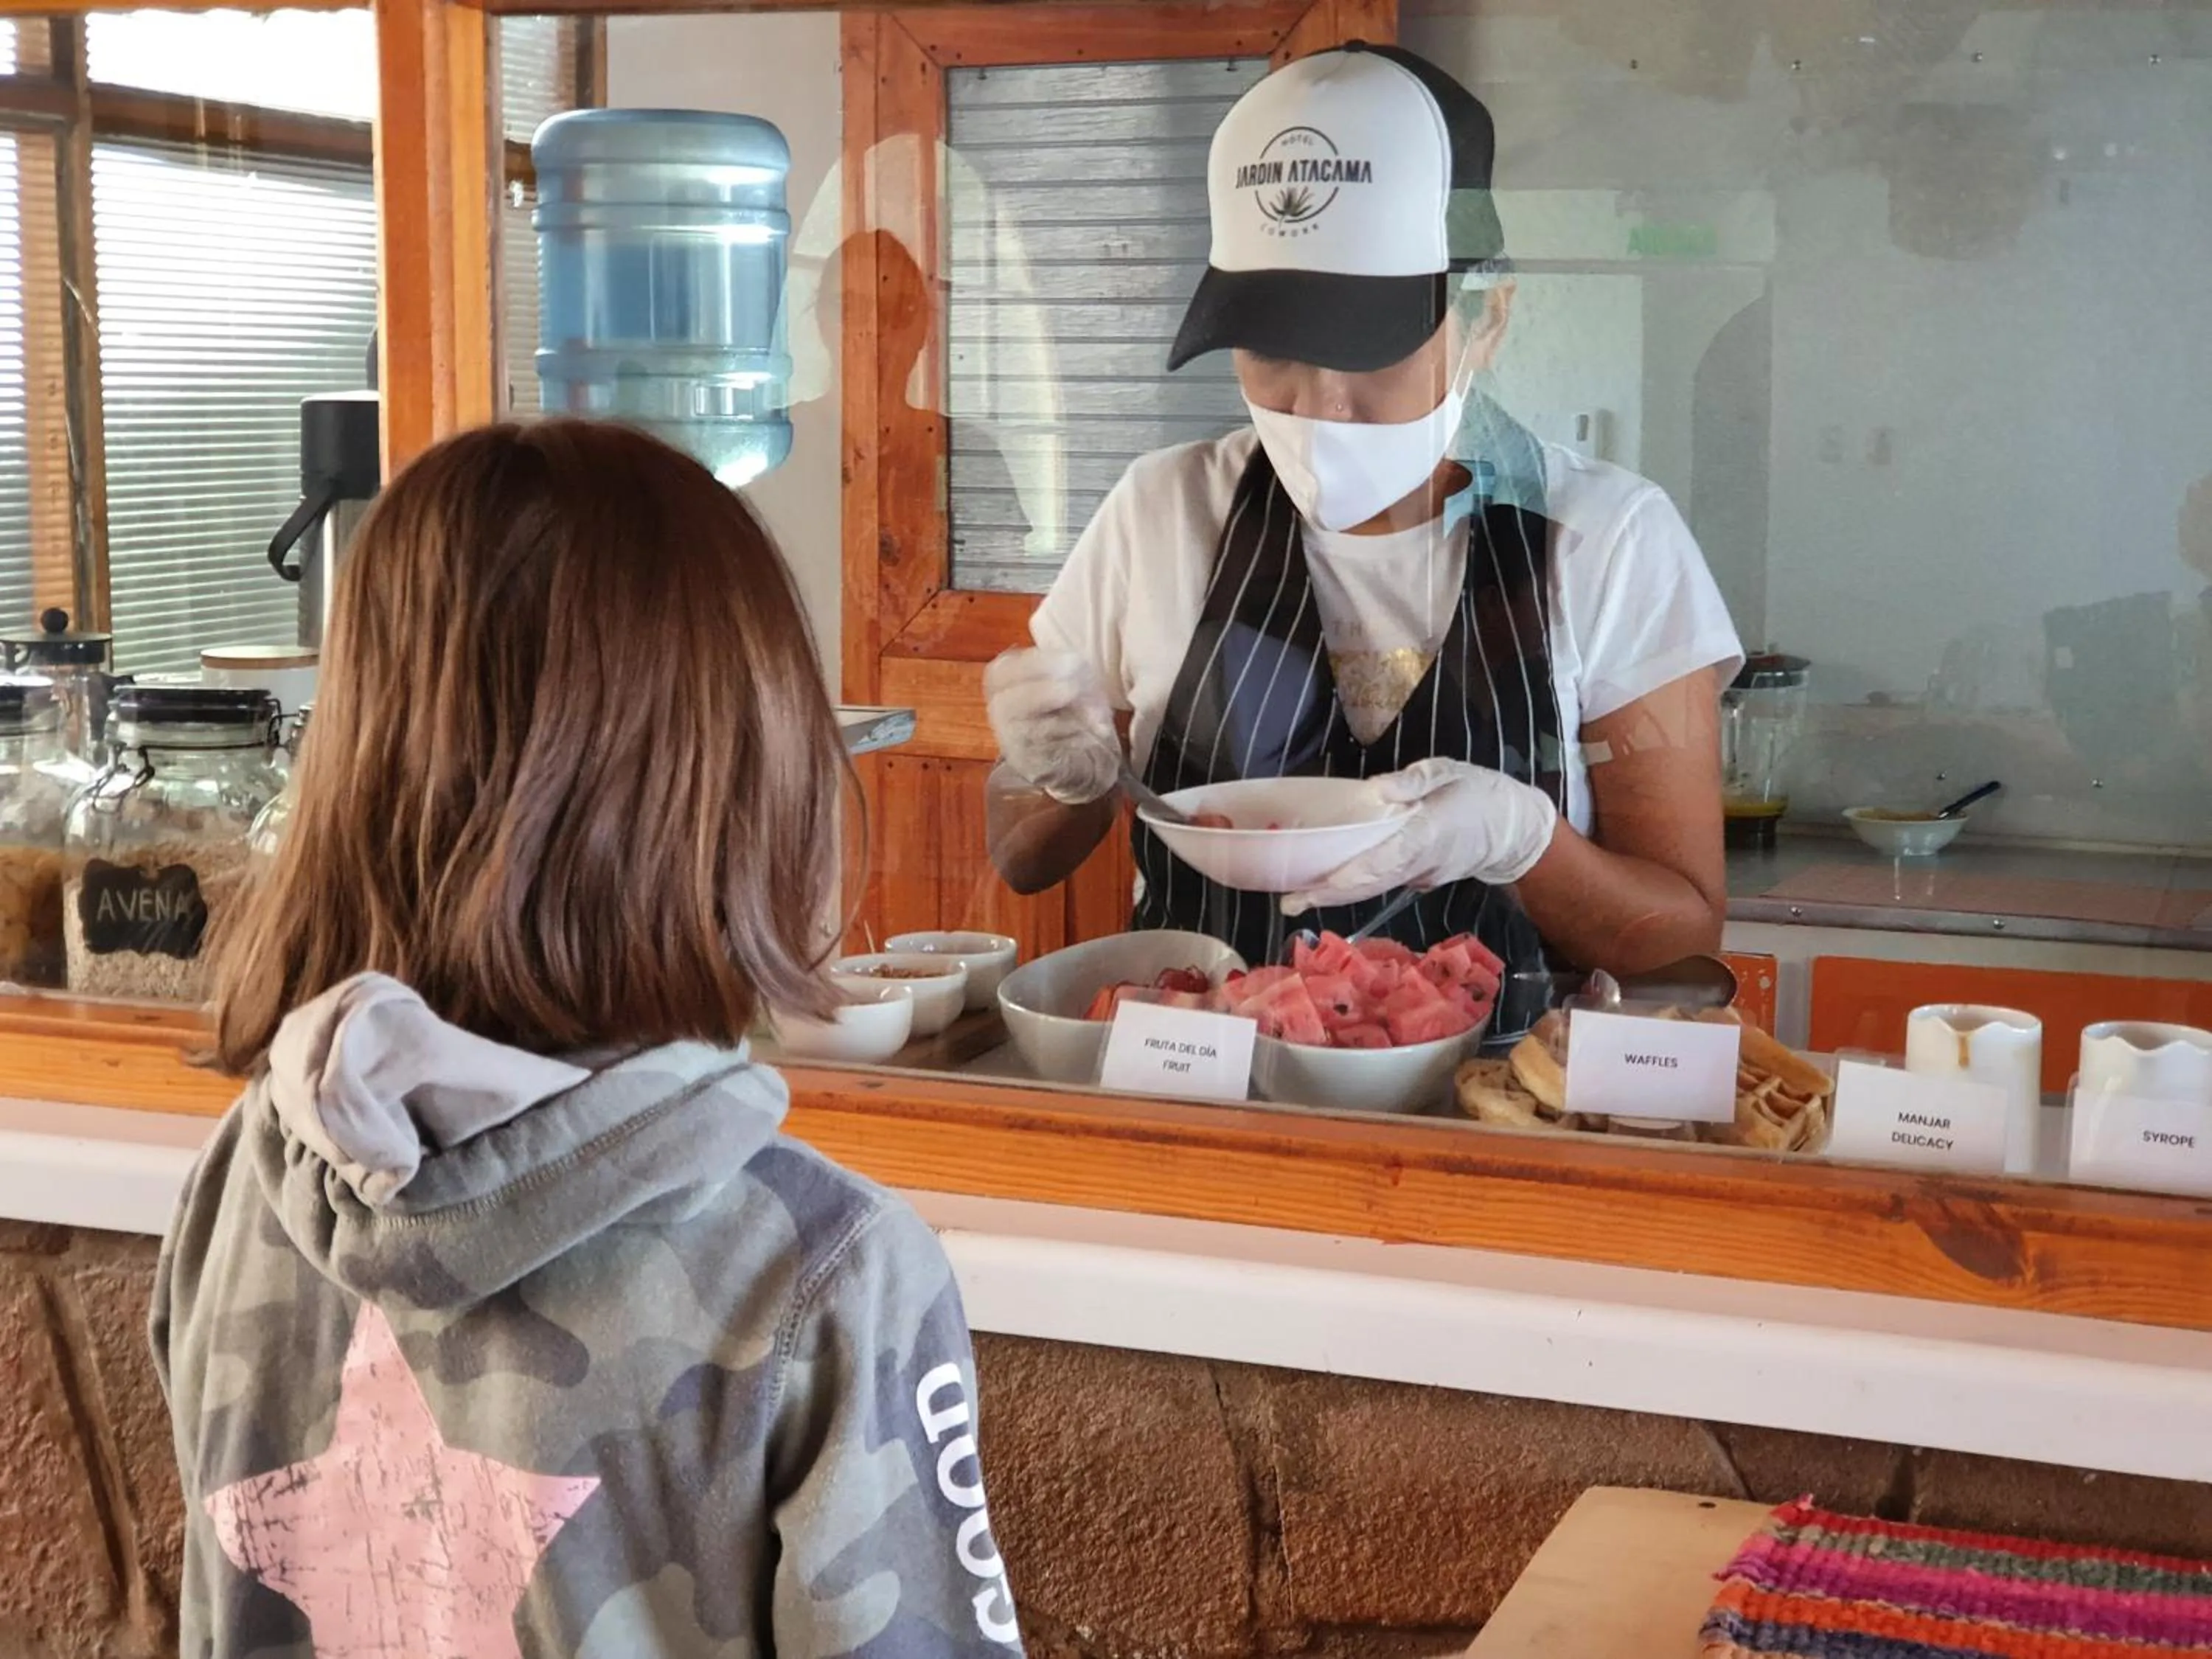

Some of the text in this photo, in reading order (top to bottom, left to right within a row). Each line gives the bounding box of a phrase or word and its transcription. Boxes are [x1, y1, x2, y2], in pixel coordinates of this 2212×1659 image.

[1236, 159, 1372, 189] JARDIN ATACAMA
[96, 887, 191, 922] AVENA
[1144, 1037, 1177, 1052] FRUTA
[1178, 1042, 1197, 1056] DEL
[1162, 1060, 1192, 1074] FRUIT
[1624, 1053, 1678, 1068] WAFFLES
[1898, 1111, 1951, 1130] MANJAR
[1891, 1131, 1954, 1151] DELICACY
[2143, 1130, 2195, 1149] SYROPE
